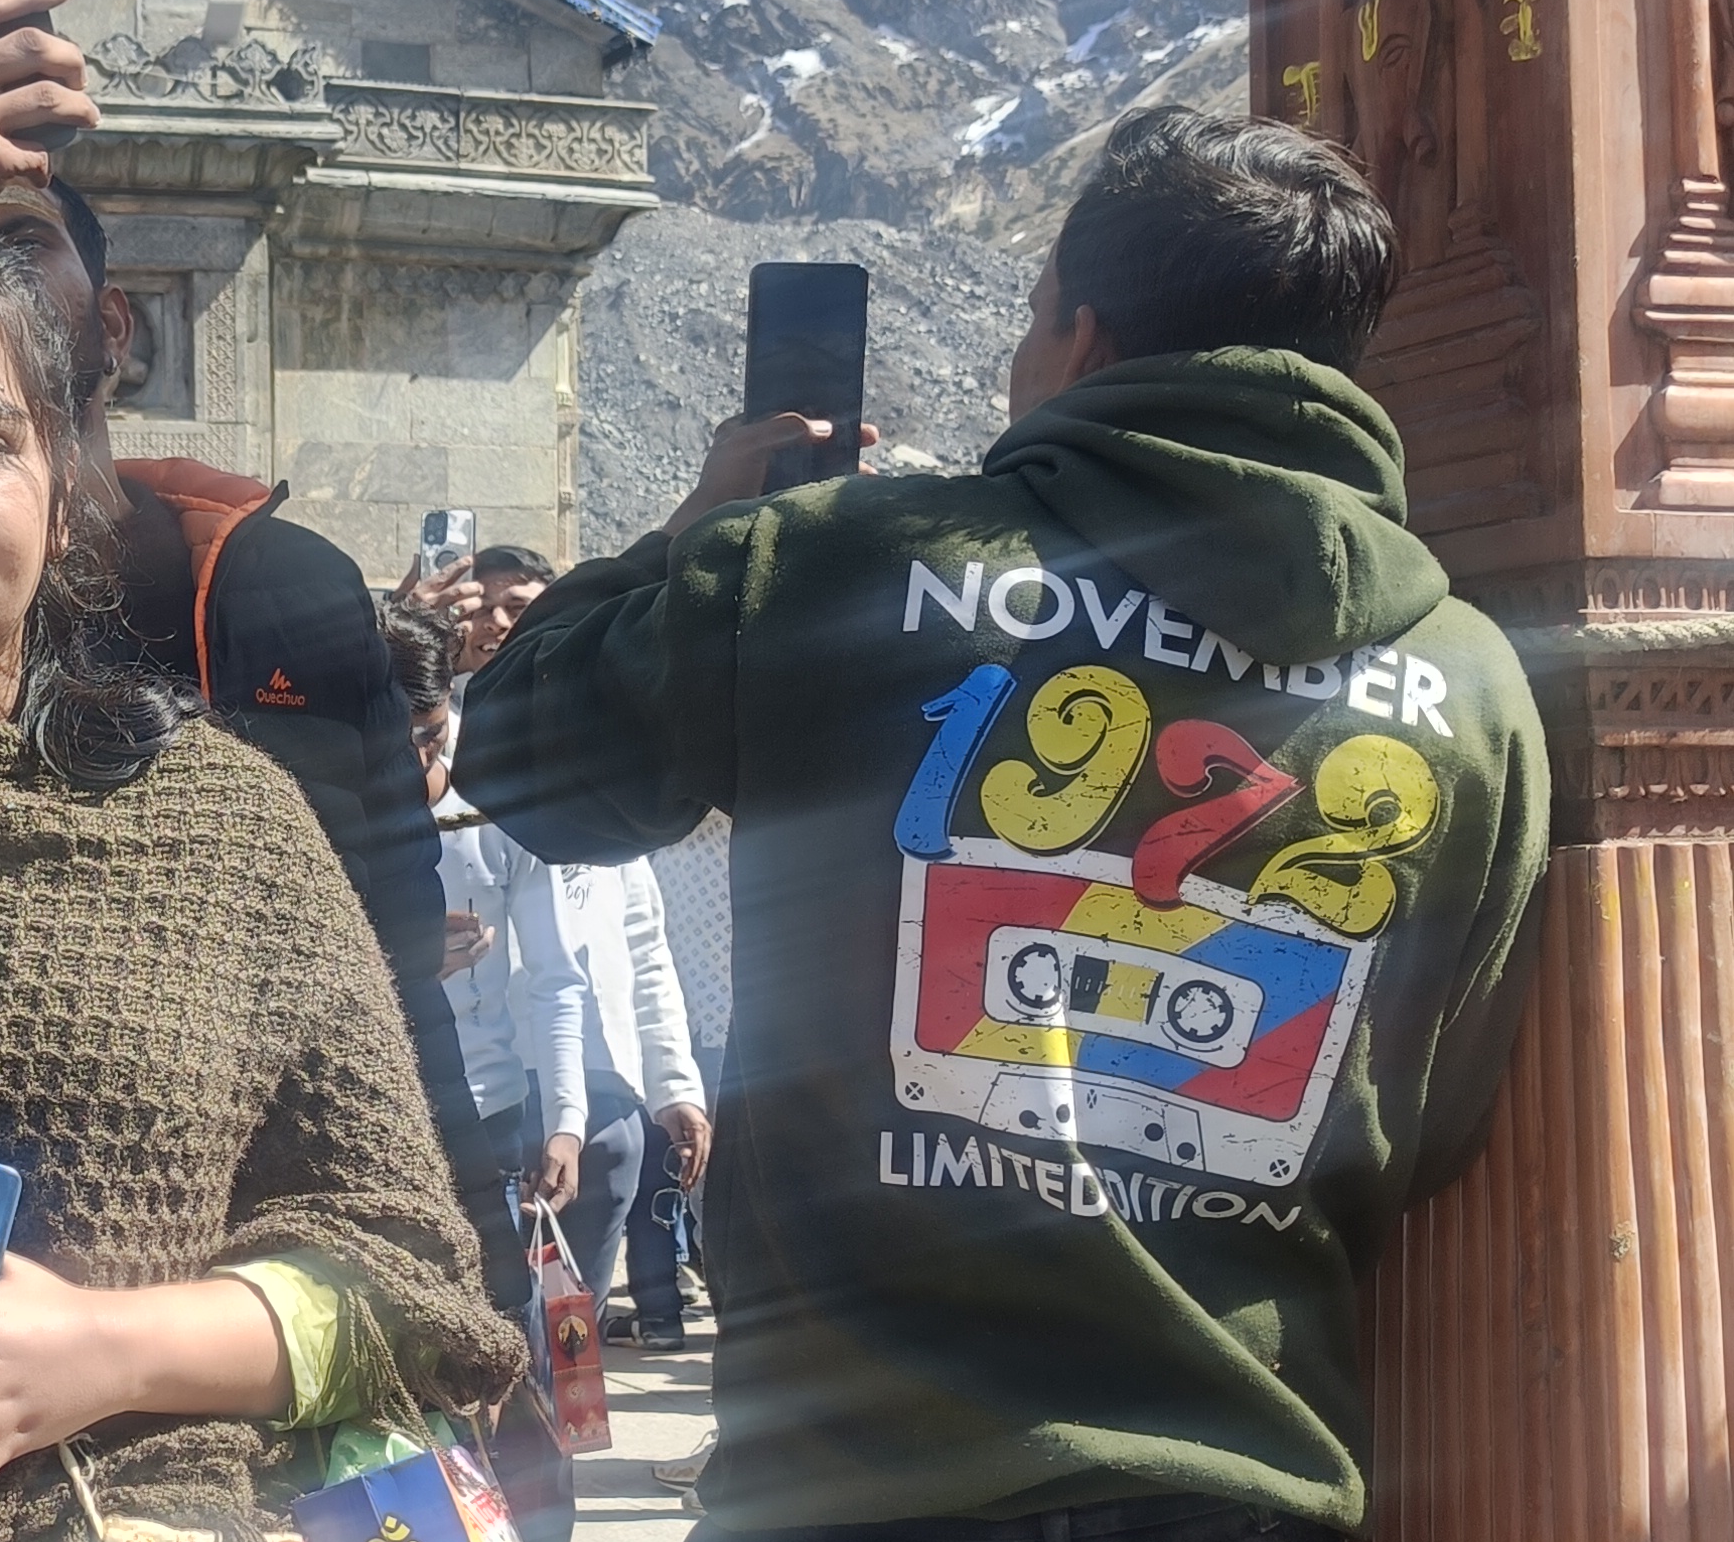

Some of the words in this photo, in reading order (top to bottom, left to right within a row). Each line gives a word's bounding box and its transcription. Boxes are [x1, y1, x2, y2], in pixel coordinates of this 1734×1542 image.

[255, 687, 306, 706] Quechua
[894, 664, 1442, 939] 1972
[879, 1131, 1108, 1217] LIMITED
[1094, 1166, 1302, 1232] DITION
